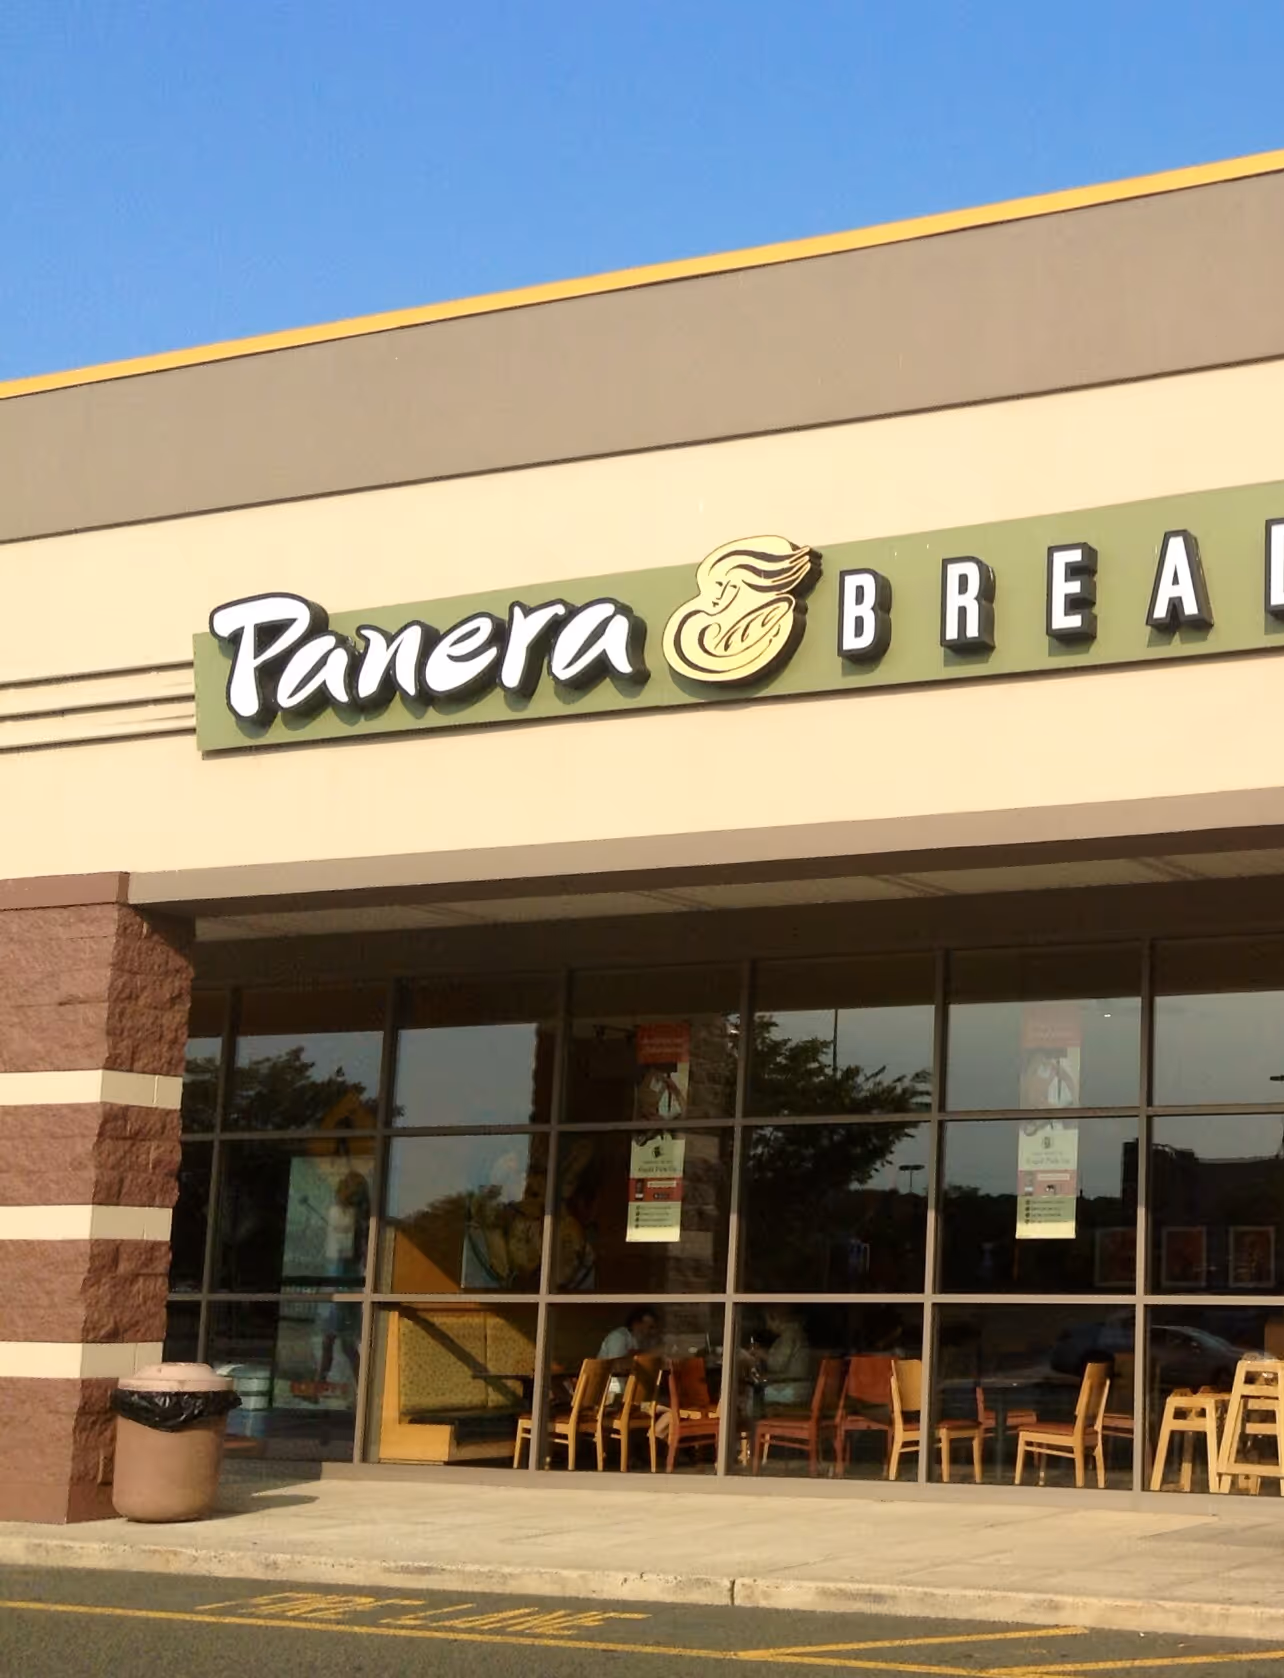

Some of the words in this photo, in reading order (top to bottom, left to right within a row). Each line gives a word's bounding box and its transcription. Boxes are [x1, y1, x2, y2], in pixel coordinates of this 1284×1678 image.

[210, 592, 642, 724] Panera
[194, 1591, 427, 1619] FIRE
[379, 1603, 653, 1636] LANE
